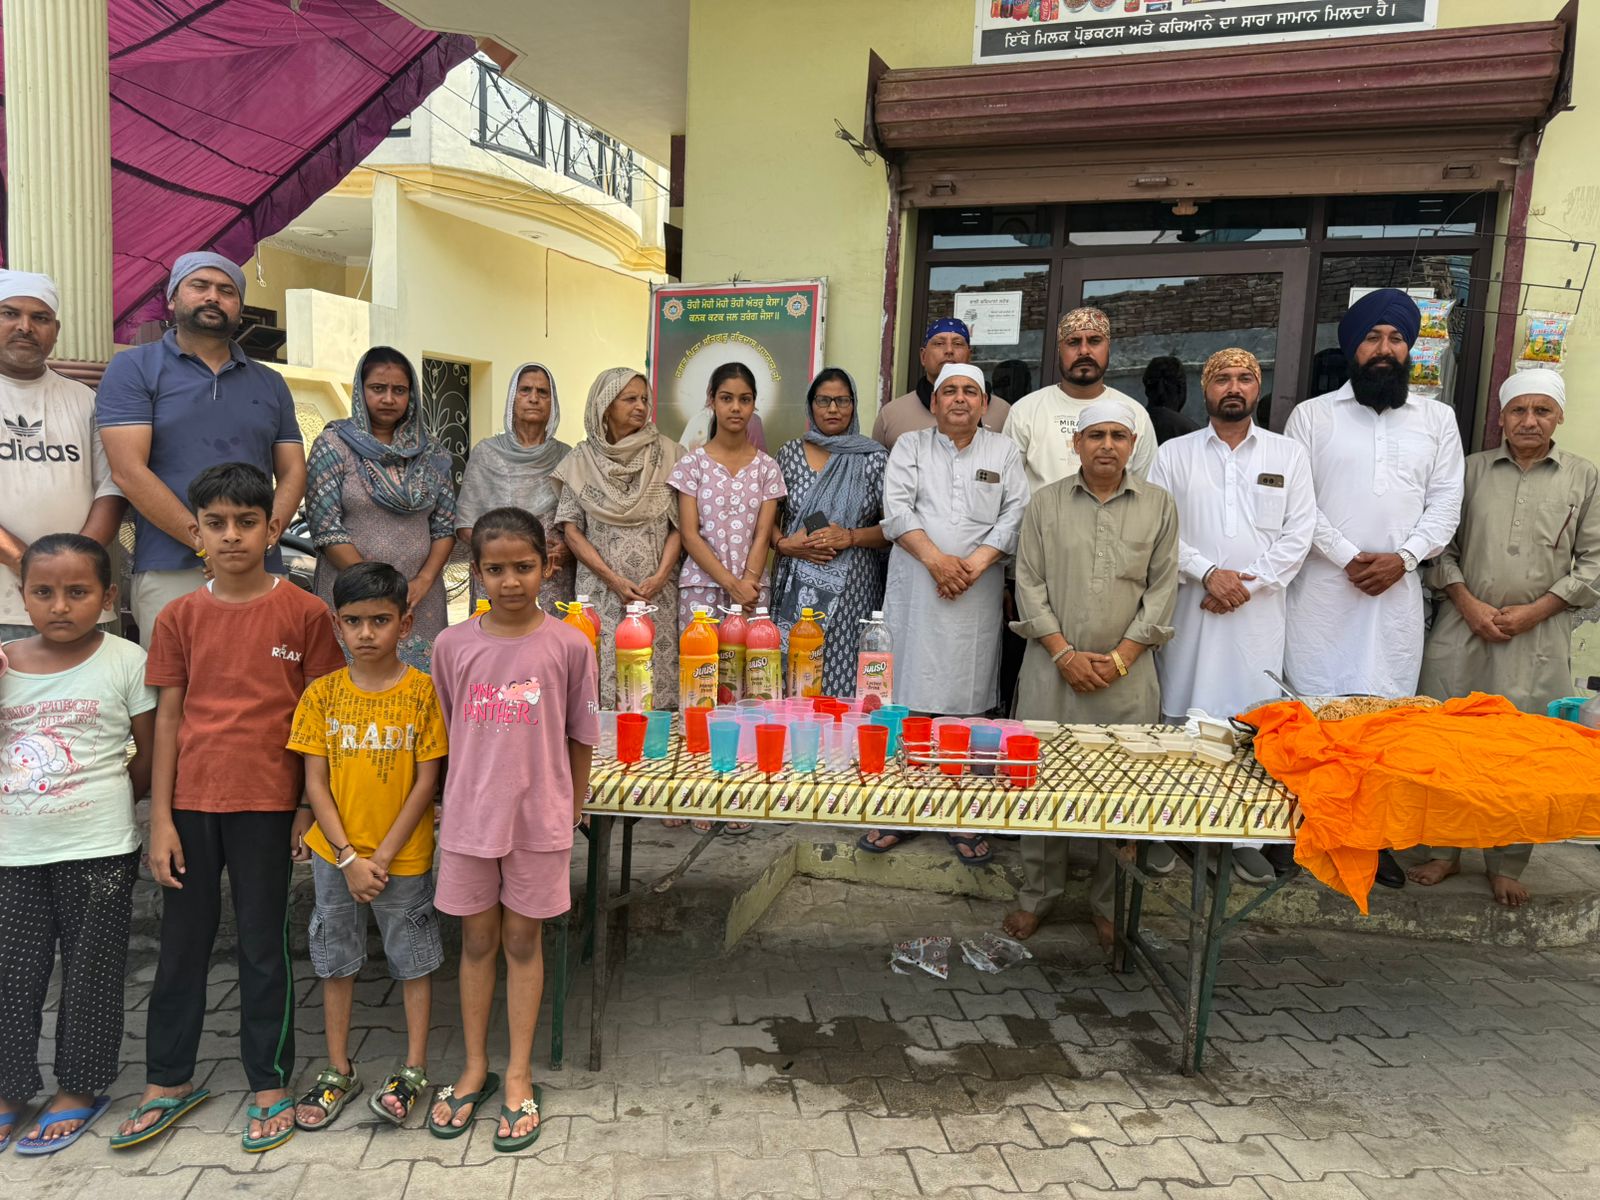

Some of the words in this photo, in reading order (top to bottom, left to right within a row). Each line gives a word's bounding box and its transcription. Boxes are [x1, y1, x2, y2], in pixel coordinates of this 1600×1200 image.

[1005, 30, 1031, 48] ਇੱਥੇ
[1034, 29, 1070, 45] ਮਿਲਕ
[1129, 20, 1156, 36] ਅਤੇ
[1158, 14, 1216, 34] ਕਰਿਆਨੇ
[1219, 16, 1237, 30] ਦਾ
[1240, 14, 1272, 28] ਸਾਰਾ
[1276, 10, 1320, 24] ਸਾਮਾਨ
[1324, 5, 1372, 22] ਮਿਲਦਾ
[0, 438, 80, 462] adidas
[468, 682, 500, 702] PINK
[40, 699, 100, 714] PIECE
[464, 701, 538, 726] PANTHER
